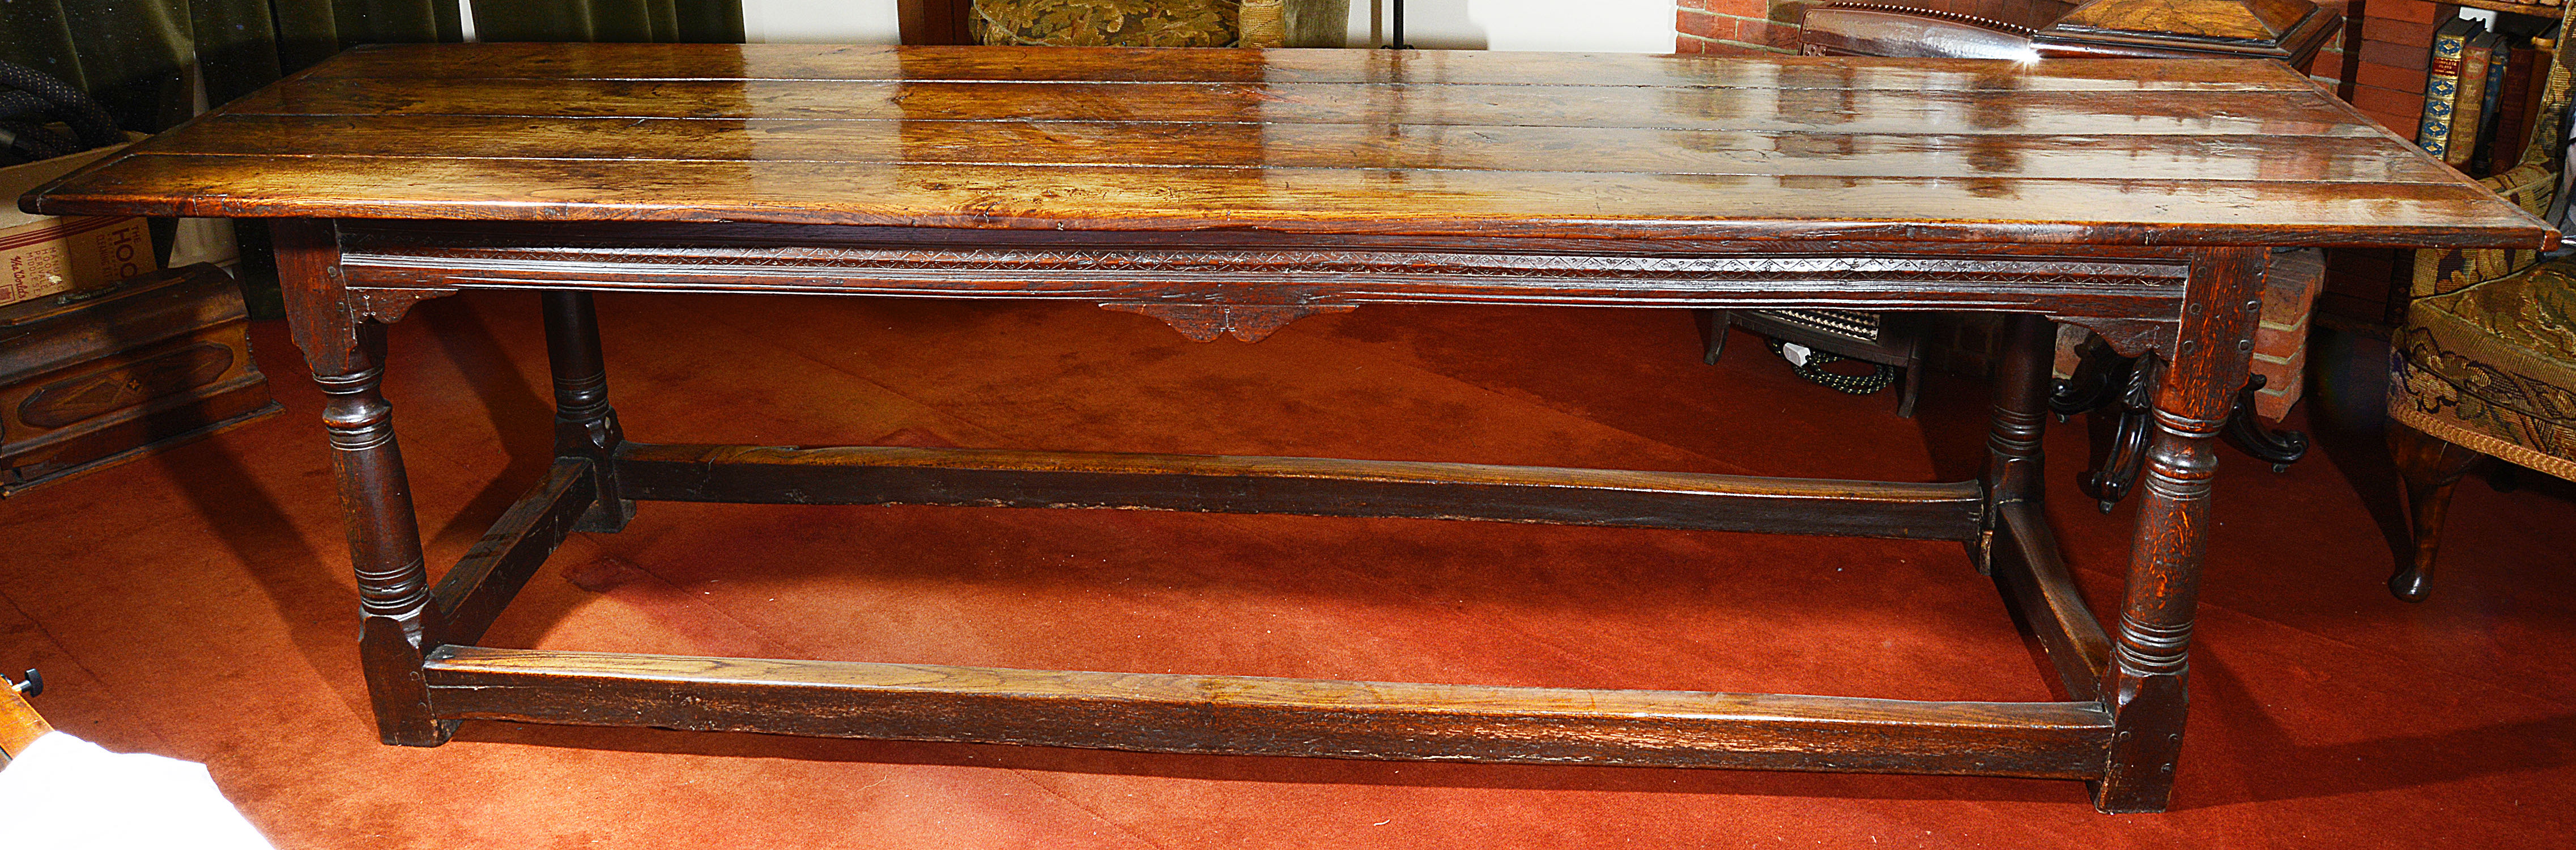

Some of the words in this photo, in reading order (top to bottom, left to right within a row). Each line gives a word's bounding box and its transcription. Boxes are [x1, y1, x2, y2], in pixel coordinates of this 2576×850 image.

[130, 226, 141, 244] THE
[11, 256, 22, 271] The
[35, 250, 49, 290] PERIVALE
